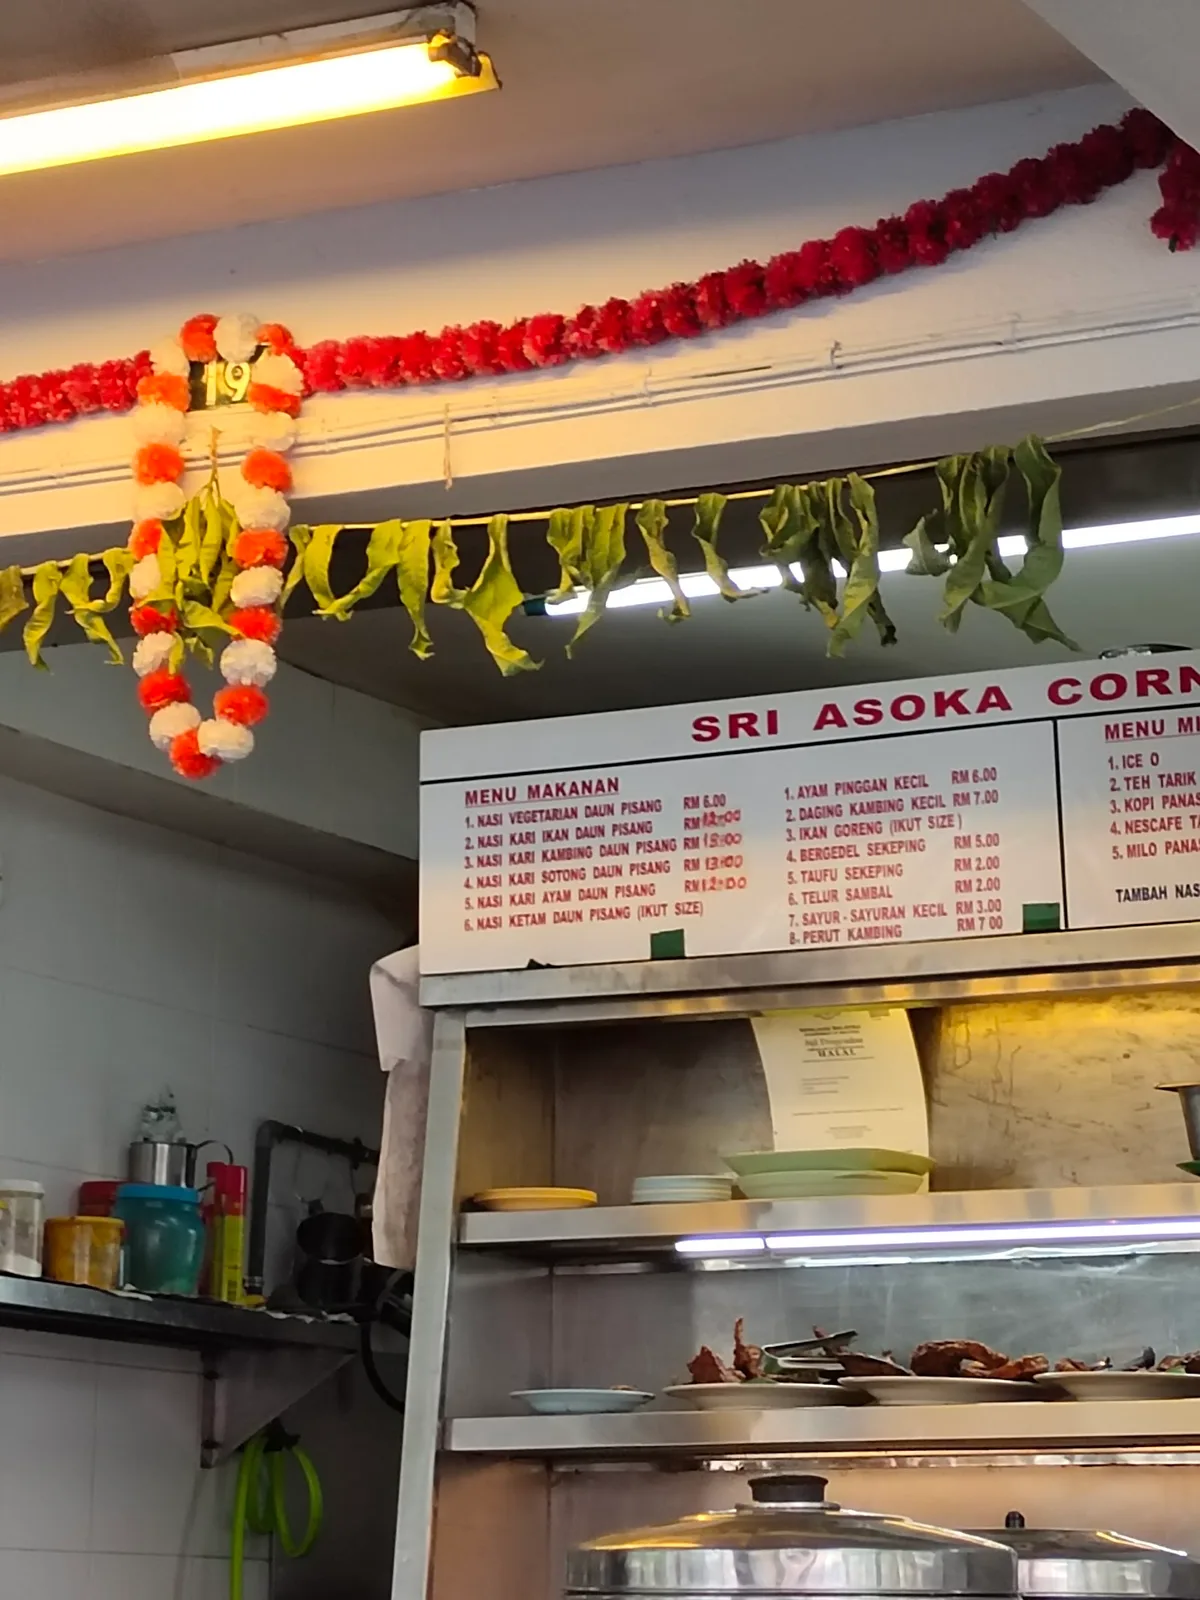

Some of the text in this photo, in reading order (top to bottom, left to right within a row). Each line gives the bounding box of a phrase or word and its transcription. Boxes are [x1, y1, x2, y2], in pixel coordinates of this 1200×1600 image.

[201, 361, 251, 406] 19
[691, 709, 779, 742] SRI
[813, 685, 1013, 732] ASOKA
[1104, 718, 1165, 741] MENU
[1108, 756, 1119, 770] 1.
[1122, 753, 1143, 769] ICE
[465, 777, 619, 806] MENU MAKANAN
[785, 767, 997, 800] 1. AYAM PINGGAN KECIL RM 6.00
[1109, 772, 1196, 792] 2. TEH TARIK
[465, 793, 726, 829] 1. NASI VEGETARIAN DAUN PISANG RM 6.00
[785, 789, 999, 822] 2. DAGING KAMBING KECIL RM 7.00
[1110, 799, 1121, 814] 3.
[1124, 796, 1154, 812] KOPI
[465, 836, 474, 850] 2.
[477, 834, 503, 849] NASI
[509, 831, 536, 846] KARI
[542, 828, 569, 843] IKAN
[575, 825, 605, 840] DAUN
[612, 821, 653, 837] PISANG
[684, 817, 700, 830] RM
[786, 829, 796, 842] 3.
[799, 825, 828, 840] IKAN
[834, 821, 883, 838] GORENG
[890, 817, 922, 837] (IKUT
[1110, 821, 1121, 835] 4.
[1125, 816, 1183, 835] NESCAFE
[464, 856, 474, 869] 3.
[476, 854, 502, 868] NASI
[508, 851, 535, 866] KARI
[541, 845, 593, 863] KAMBING
[599, 842, 629, 857] DAUN
[636, 838, 677, 855] PISANG
[684, 836, 700, 850] RM
[786, 832, 1000, 863] 4. BERGEDEL SEKEPING RM 5.00
[1112, 838, 1200, 860] 5. MILO PANA
[464, 877, 473, 889] 4.
[476, 874, 502, 889] NASI
[508, 872, 535, 886] KARI
[541, 867, 587, 883] SOTONG
[593, 864, 623, 879] DAUN
[629, 860, 671, 877] PISANG
[684, 858, 700, 872] RM
[787, 855, 1000, 885] 5. TAUFU SEKEPING RM 2.00
[465, 897, 474, 910] 5.
[477, 895, 503, 909] NASI
[509, 892, 536, 907] KARI
[542, 889, 571, 904] AYAM
[578, 887, 608, 901] DAUN
[615, 883, 656, 899] PISANG
[684, 879, 700, 893] RM
[788, 876, 1001, 906] 6. TELUR SAMBAL RM 2.00
[1116, 885, 1168, 903] TAMBAH
[464, 900, 704, 932] 6. NASI KETAM DAUN PISANG (IKUT SIZE)
[788, 914, 799, 927] 7.
[913, 903, 948, 918] KECIL
[956, 901, 973, 915] RM
[976, 898, 1002, 914] 3.00
[803, 929, 841, 944] PERUT
[847, 924, 903, 941] KAMBING
[957, 917, 975, 932] RM
